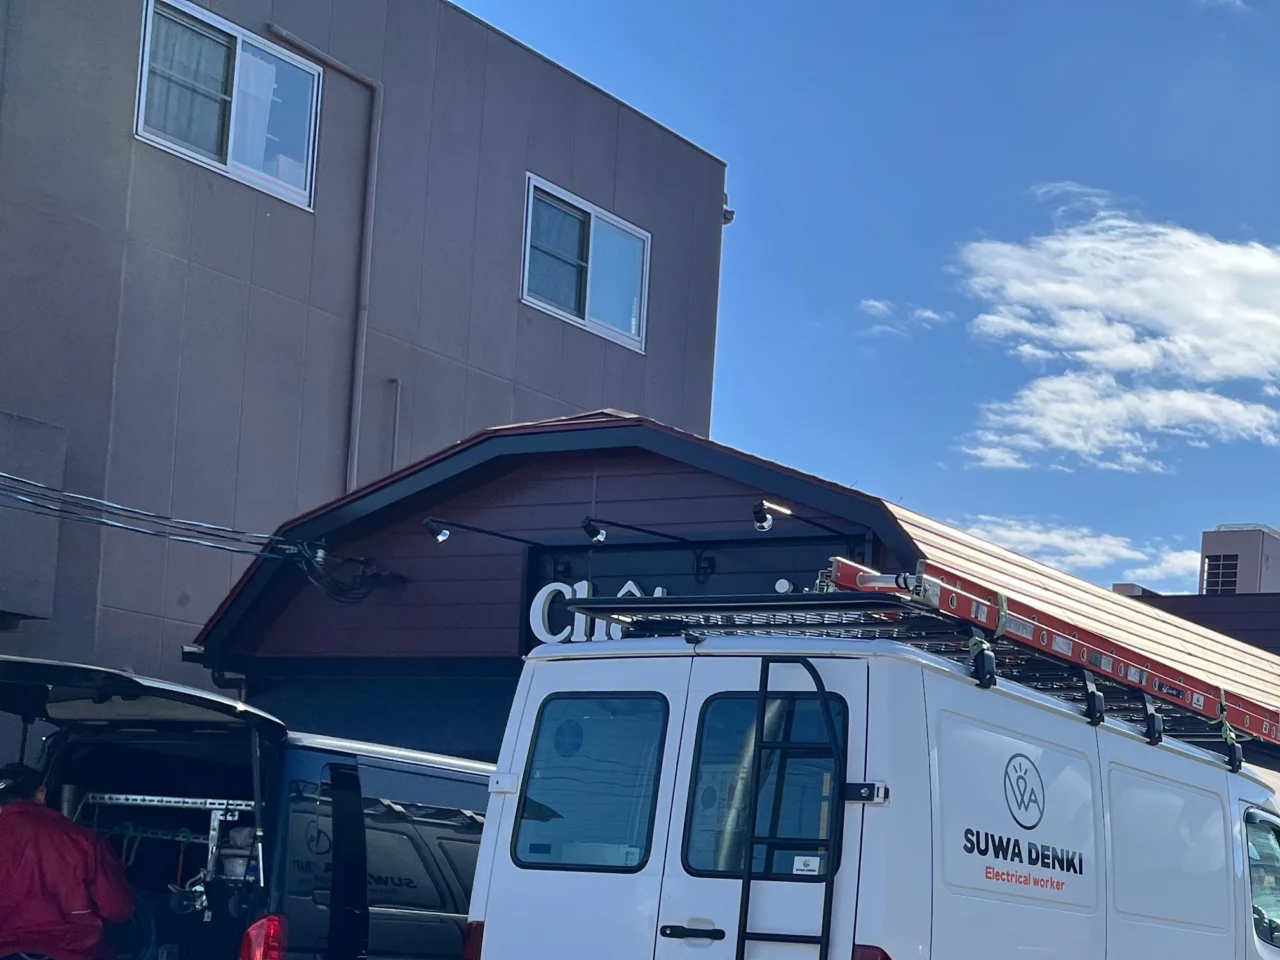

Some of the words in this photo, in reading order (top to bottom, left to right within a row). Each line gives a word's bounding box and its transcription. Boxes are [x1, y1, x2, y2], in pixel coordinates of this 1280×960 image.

[963, 828, 1023, 864] SUWA
[1027, 841, 1084, 875] DENKI
[985, 866, 1031, 886] Electrical
[1032, 876, 1066, 891] worker
